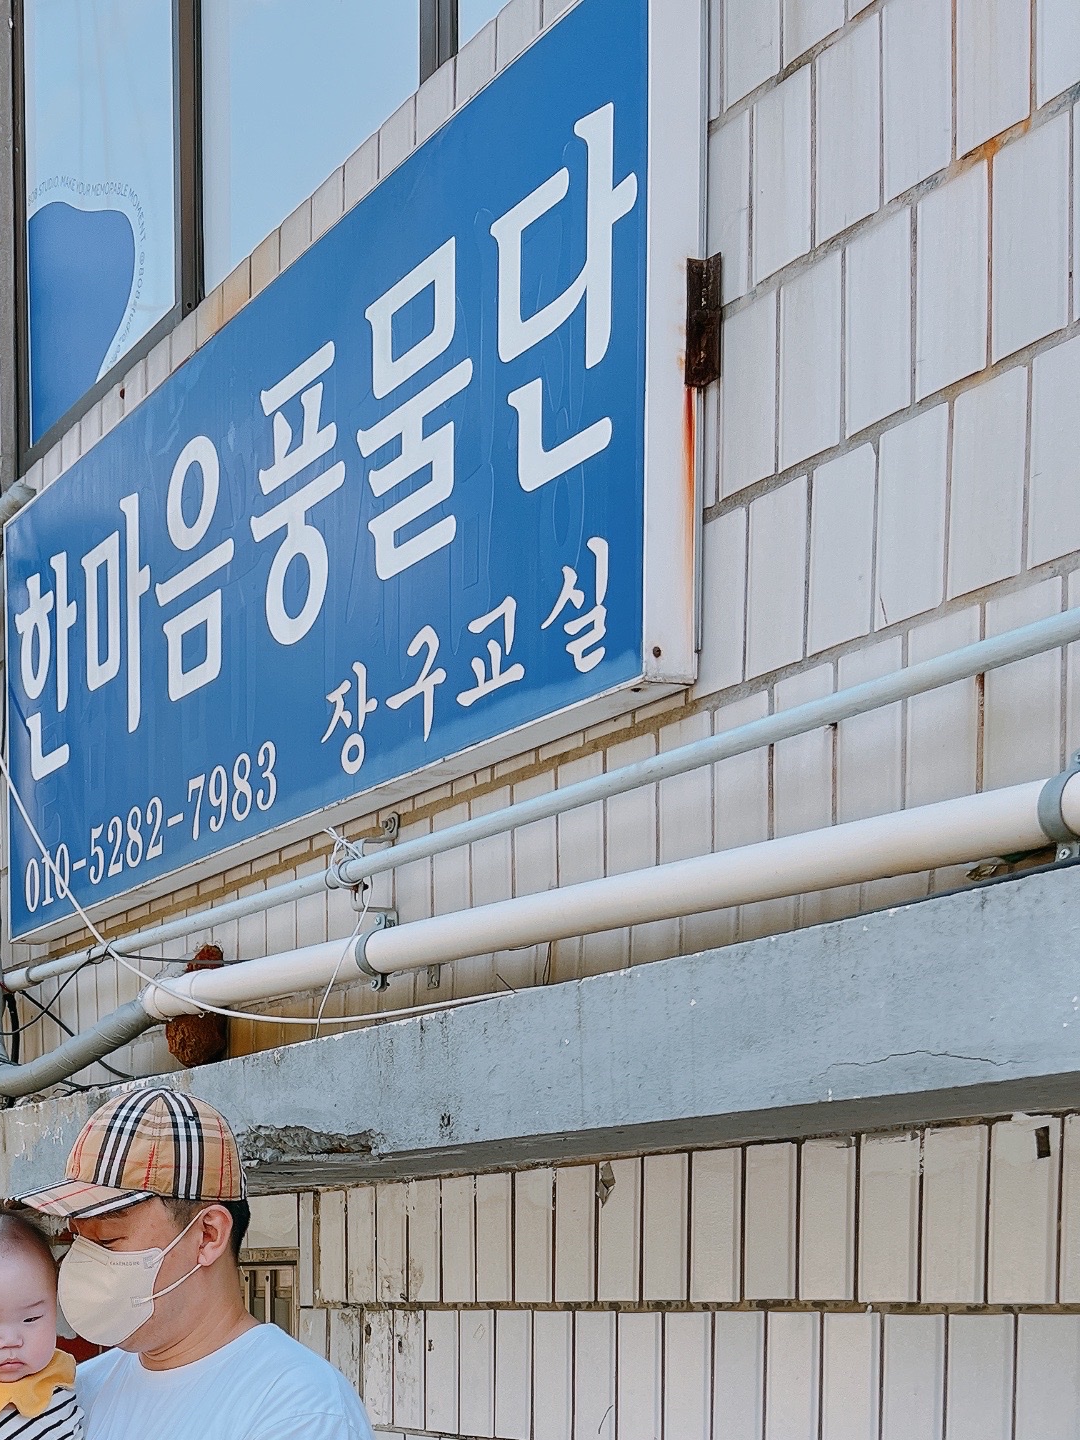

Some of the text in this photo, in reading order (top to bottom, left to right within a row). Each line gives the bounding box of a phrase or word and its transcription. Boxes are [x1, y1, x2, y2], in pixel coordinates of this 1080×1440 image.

[15, 101, 638, 781] 한마음풍물단
[321, 536, 610, 776] 장구교실
[24, 740, 279, 915] 010-5282-7983
